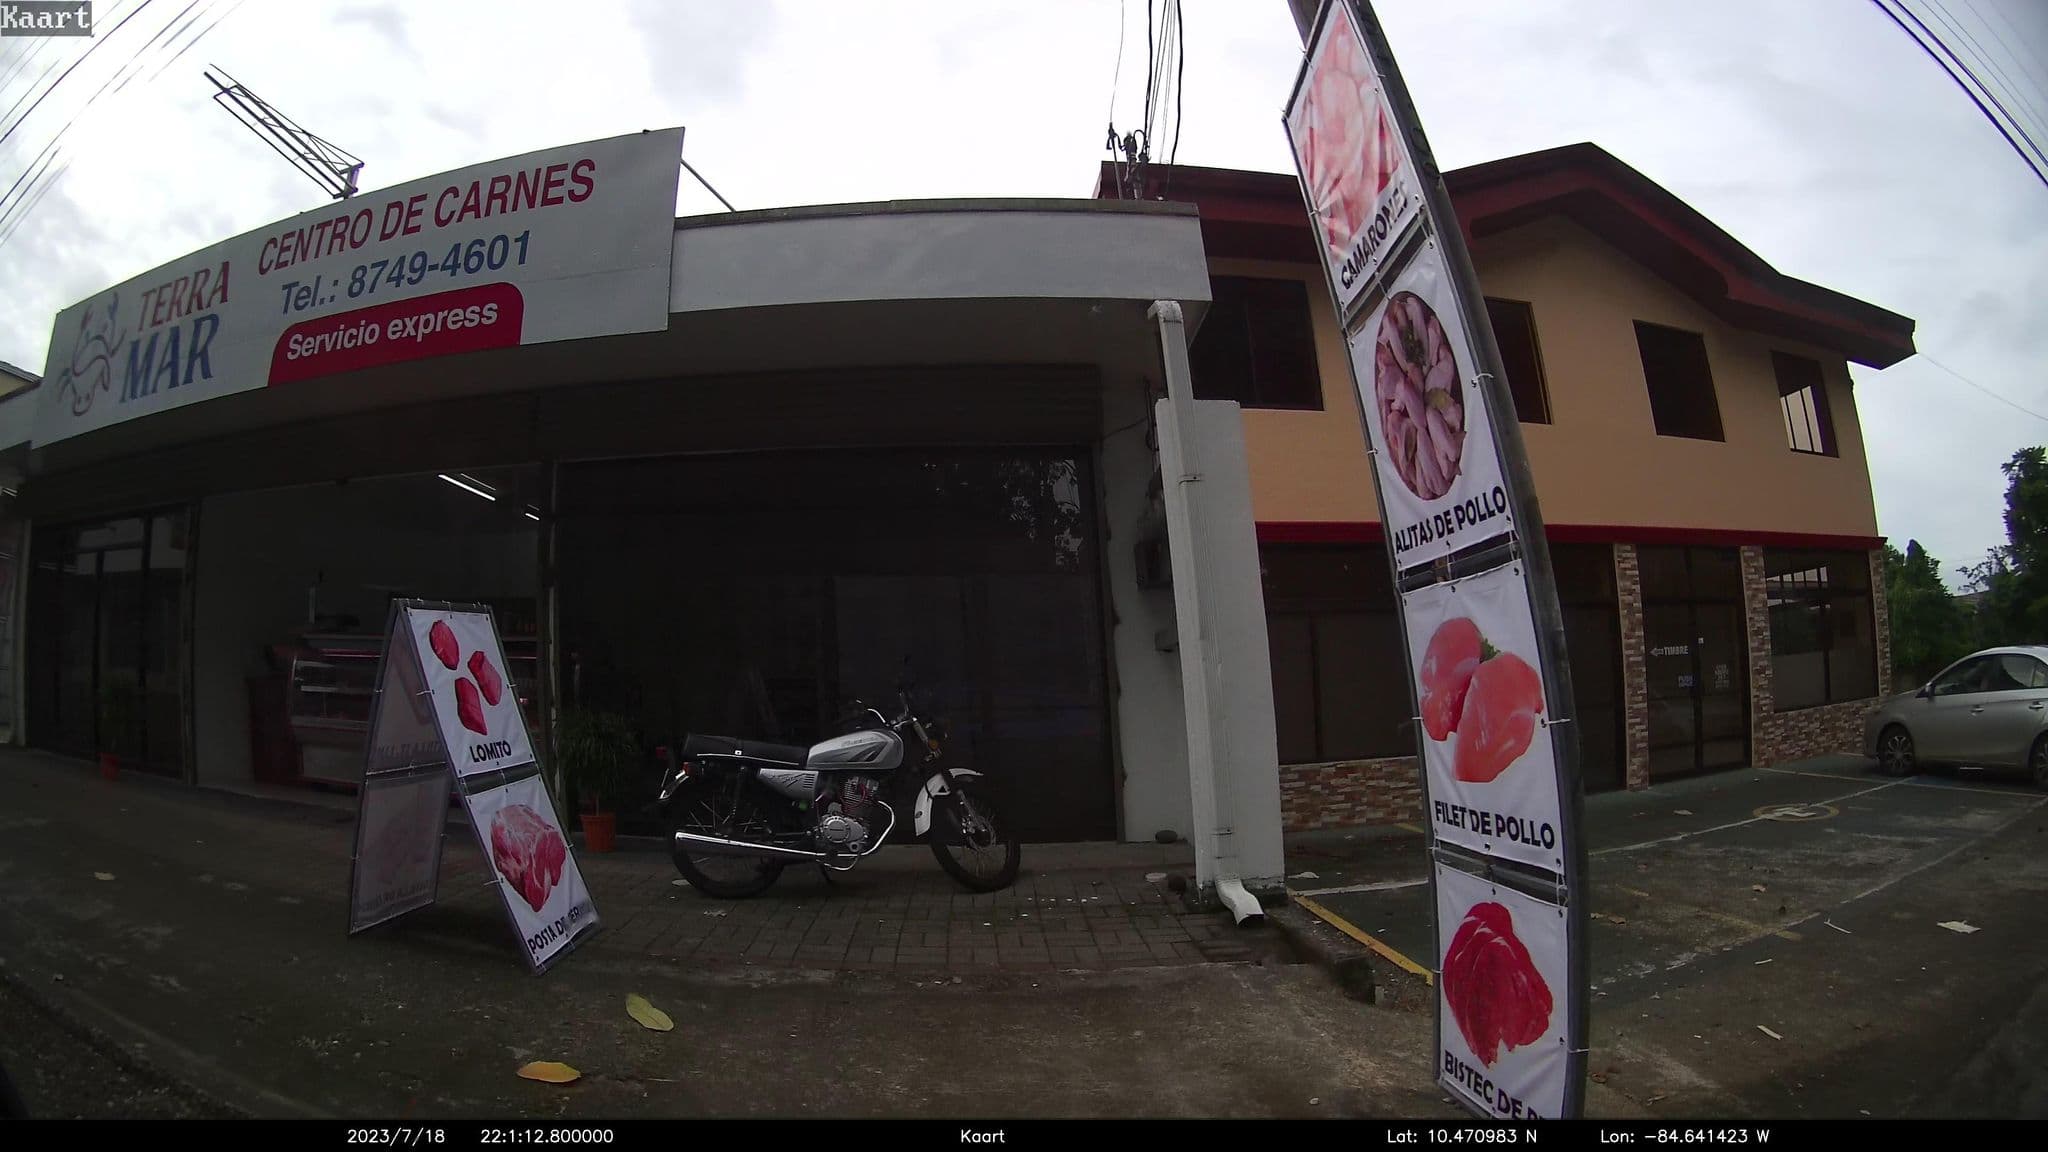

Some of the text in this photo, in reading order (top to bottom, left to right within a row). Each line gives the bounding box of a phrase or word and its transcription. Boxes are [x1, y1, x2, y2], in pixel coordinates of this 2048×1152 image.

[258, 158, 596, 275] CENTRO DE CARNES
[1341, 181, 1408, 290] CAMARONES
[138, 261, 230, 332] TERRA
[282, 229, 530, 315] Tel.: 8749-4601
[119, 314, 219, 403] MAR
[287, 302, 499, 360] Servicio express
[1395, 486, 1506, 554] ALITAS DE POLLO
[469, 740, 512, 763] LOMITO
[1434, 800, 1555, 850] FILET DE POLLO
[527, 925, 558, 955] POSTA
[1444, 1049, 1523, 1119] BISTEC DE
